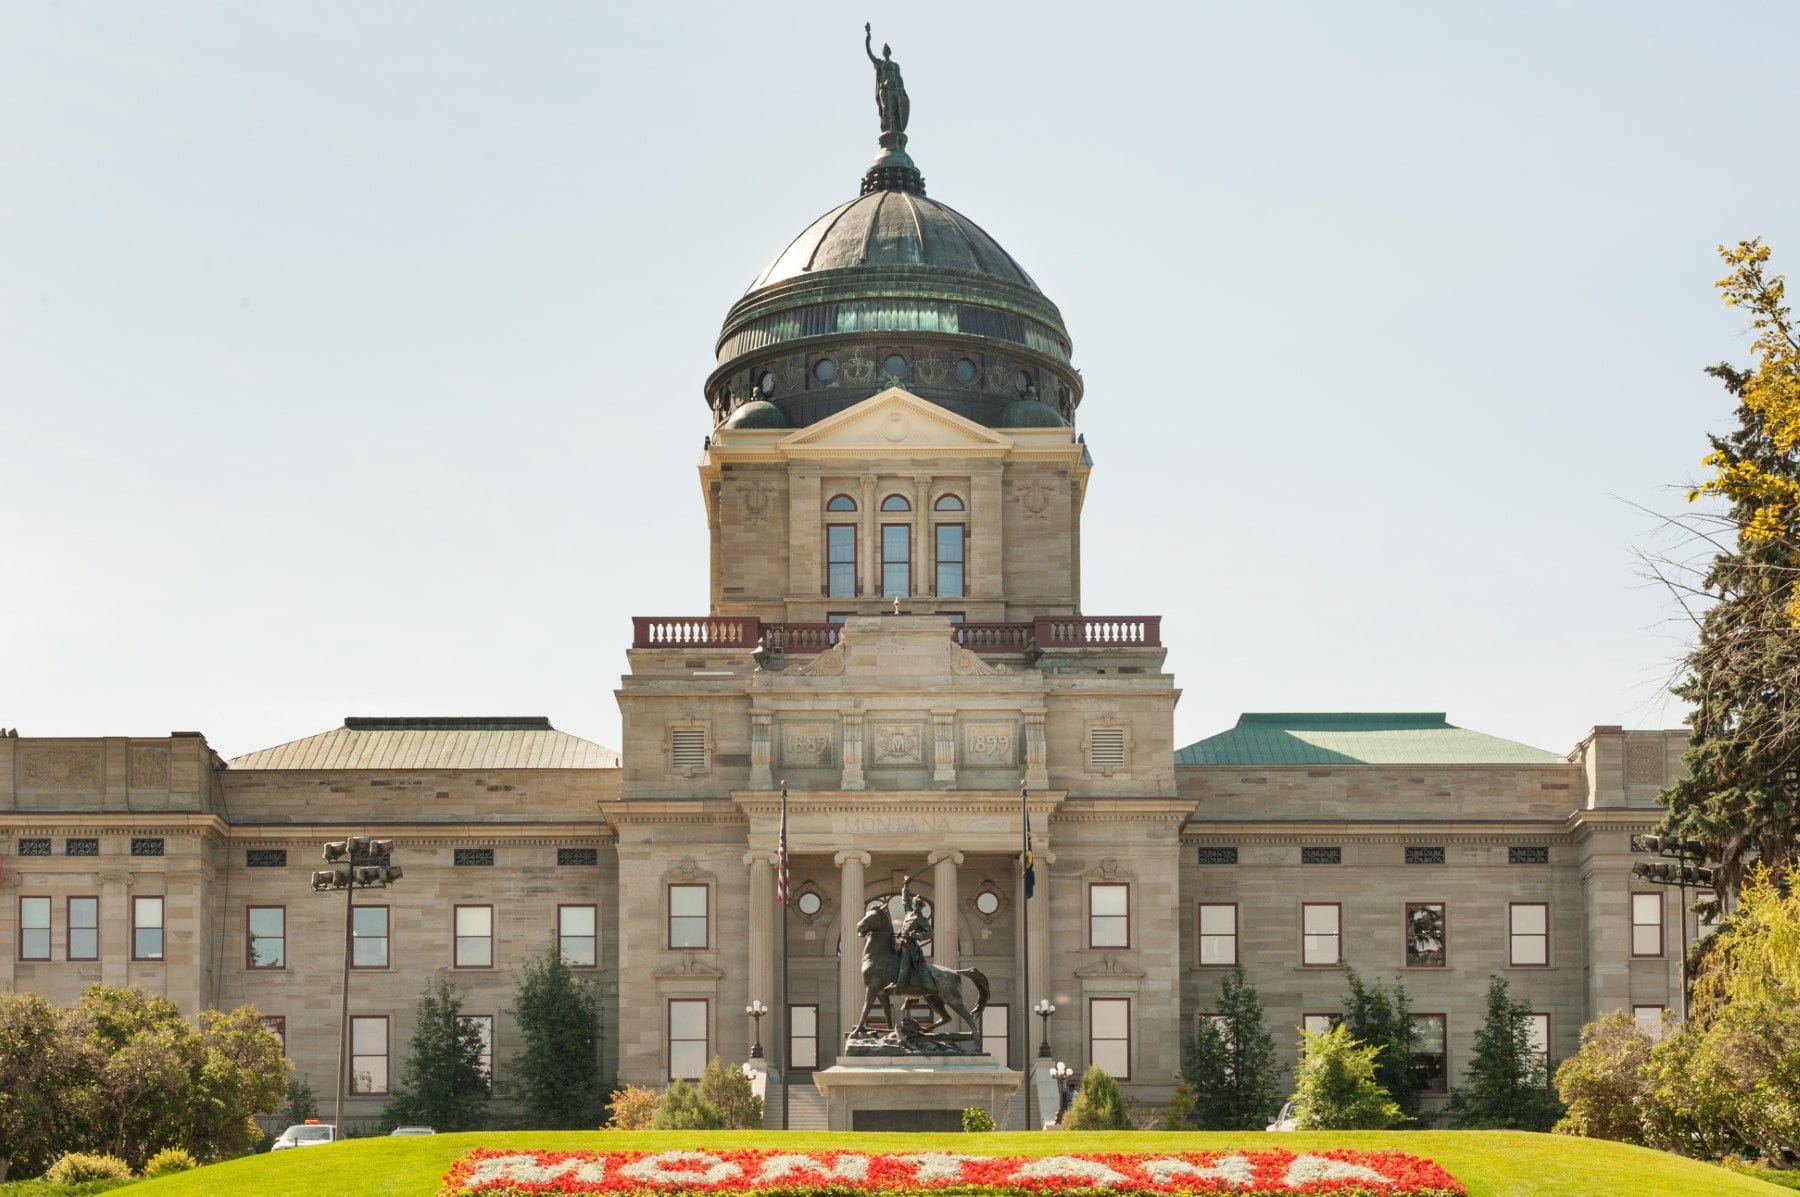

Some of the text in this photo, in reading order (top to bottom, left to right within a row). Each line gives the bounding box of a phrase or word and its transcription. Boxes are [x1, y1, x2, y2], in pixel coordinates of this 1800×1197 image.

[788, 735, 828, 756] 1889
[892, 734, 906, 752] M
[969, 735, 1010, 756] 1899
[844, 816, 953, 834] MONTANA
[464, 1150, 1394, 1188] MONTANA
